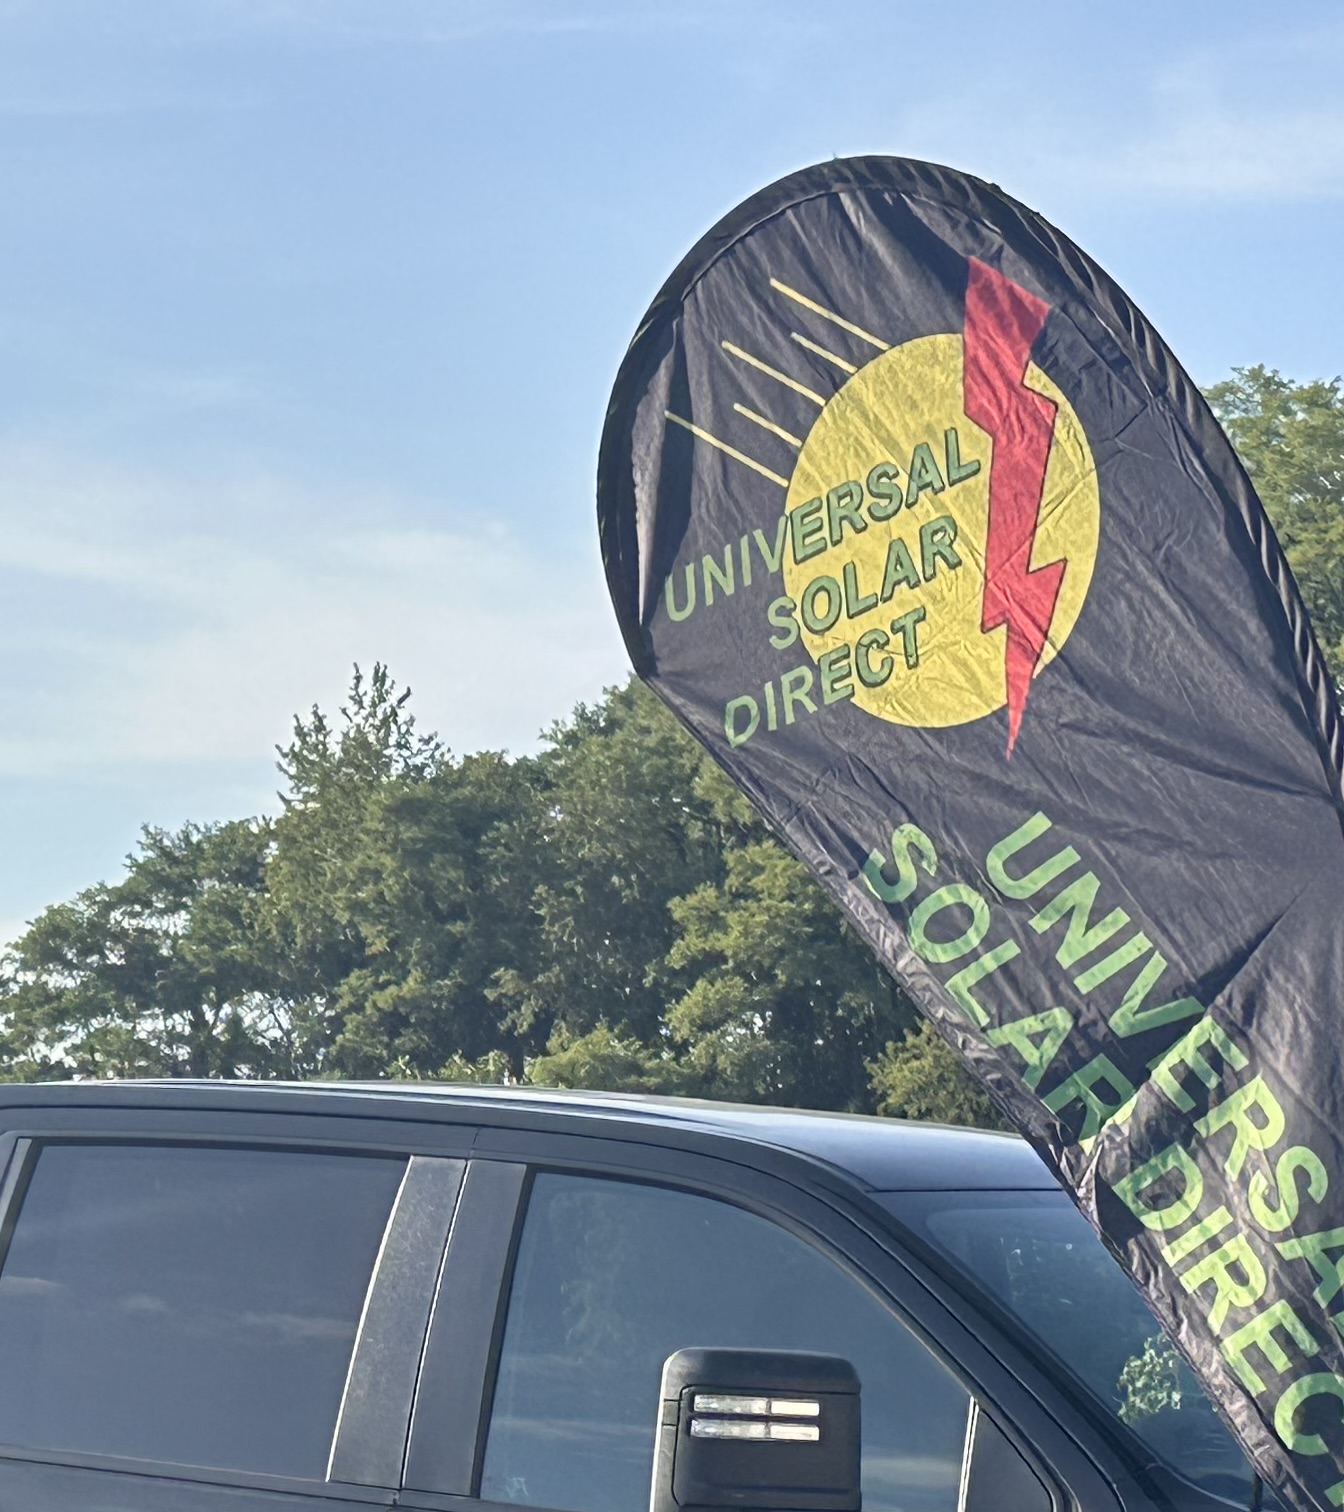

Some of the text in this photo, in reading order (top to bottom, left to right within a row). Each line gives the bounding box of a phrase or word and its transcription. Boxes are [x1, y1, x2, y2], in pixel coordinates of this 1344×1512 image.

[664, 427, 981, 623] UNIVERSAL
[767, 514, 962, 651] SOLAR
[723, 607, 926, 748] DIRECT
[863, 822, 1139, 1154] SOLAR
